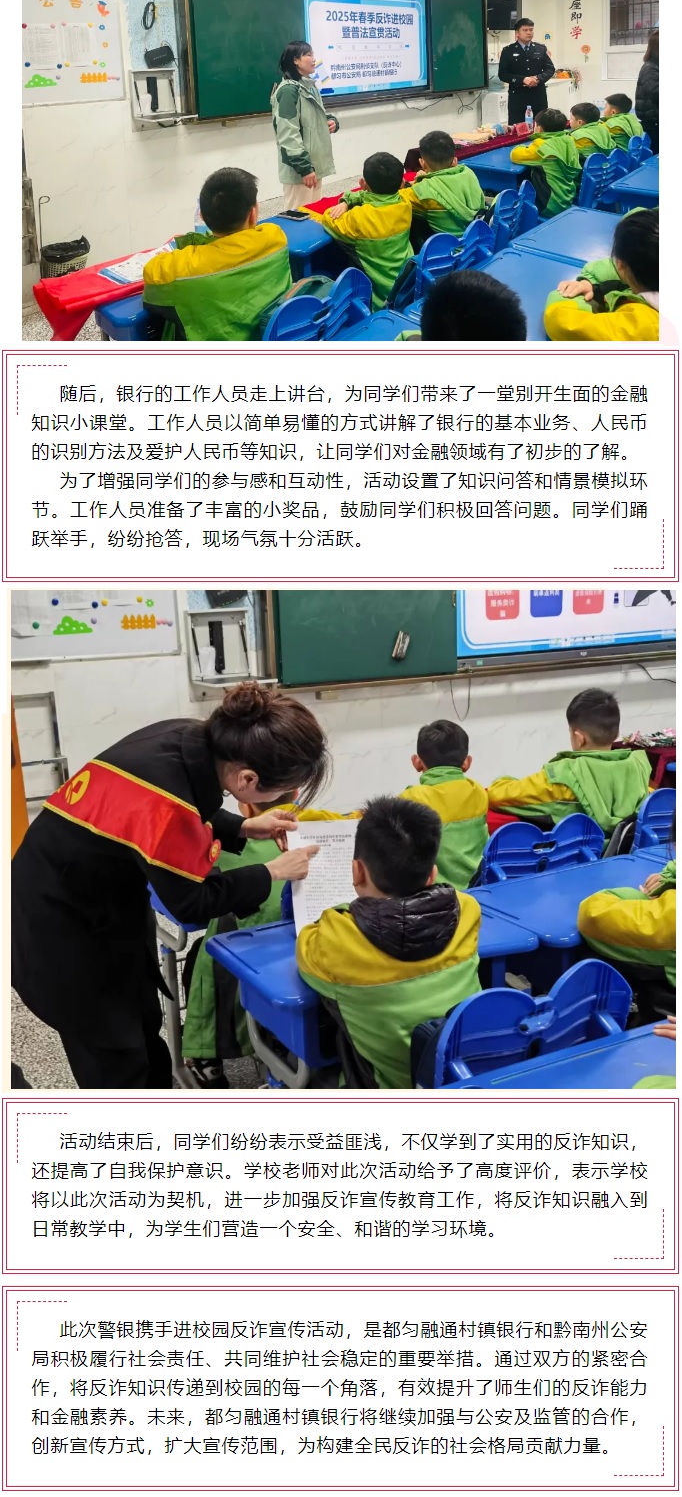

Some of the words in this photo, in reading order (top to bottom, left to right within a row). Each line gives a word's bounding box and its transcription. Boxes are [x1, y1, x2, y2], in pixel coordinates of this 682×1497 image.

[326, 10, 414, 26] 2025年春季反诈进校园
[342, 26, 400, 39] 暨普法宣贯活动
